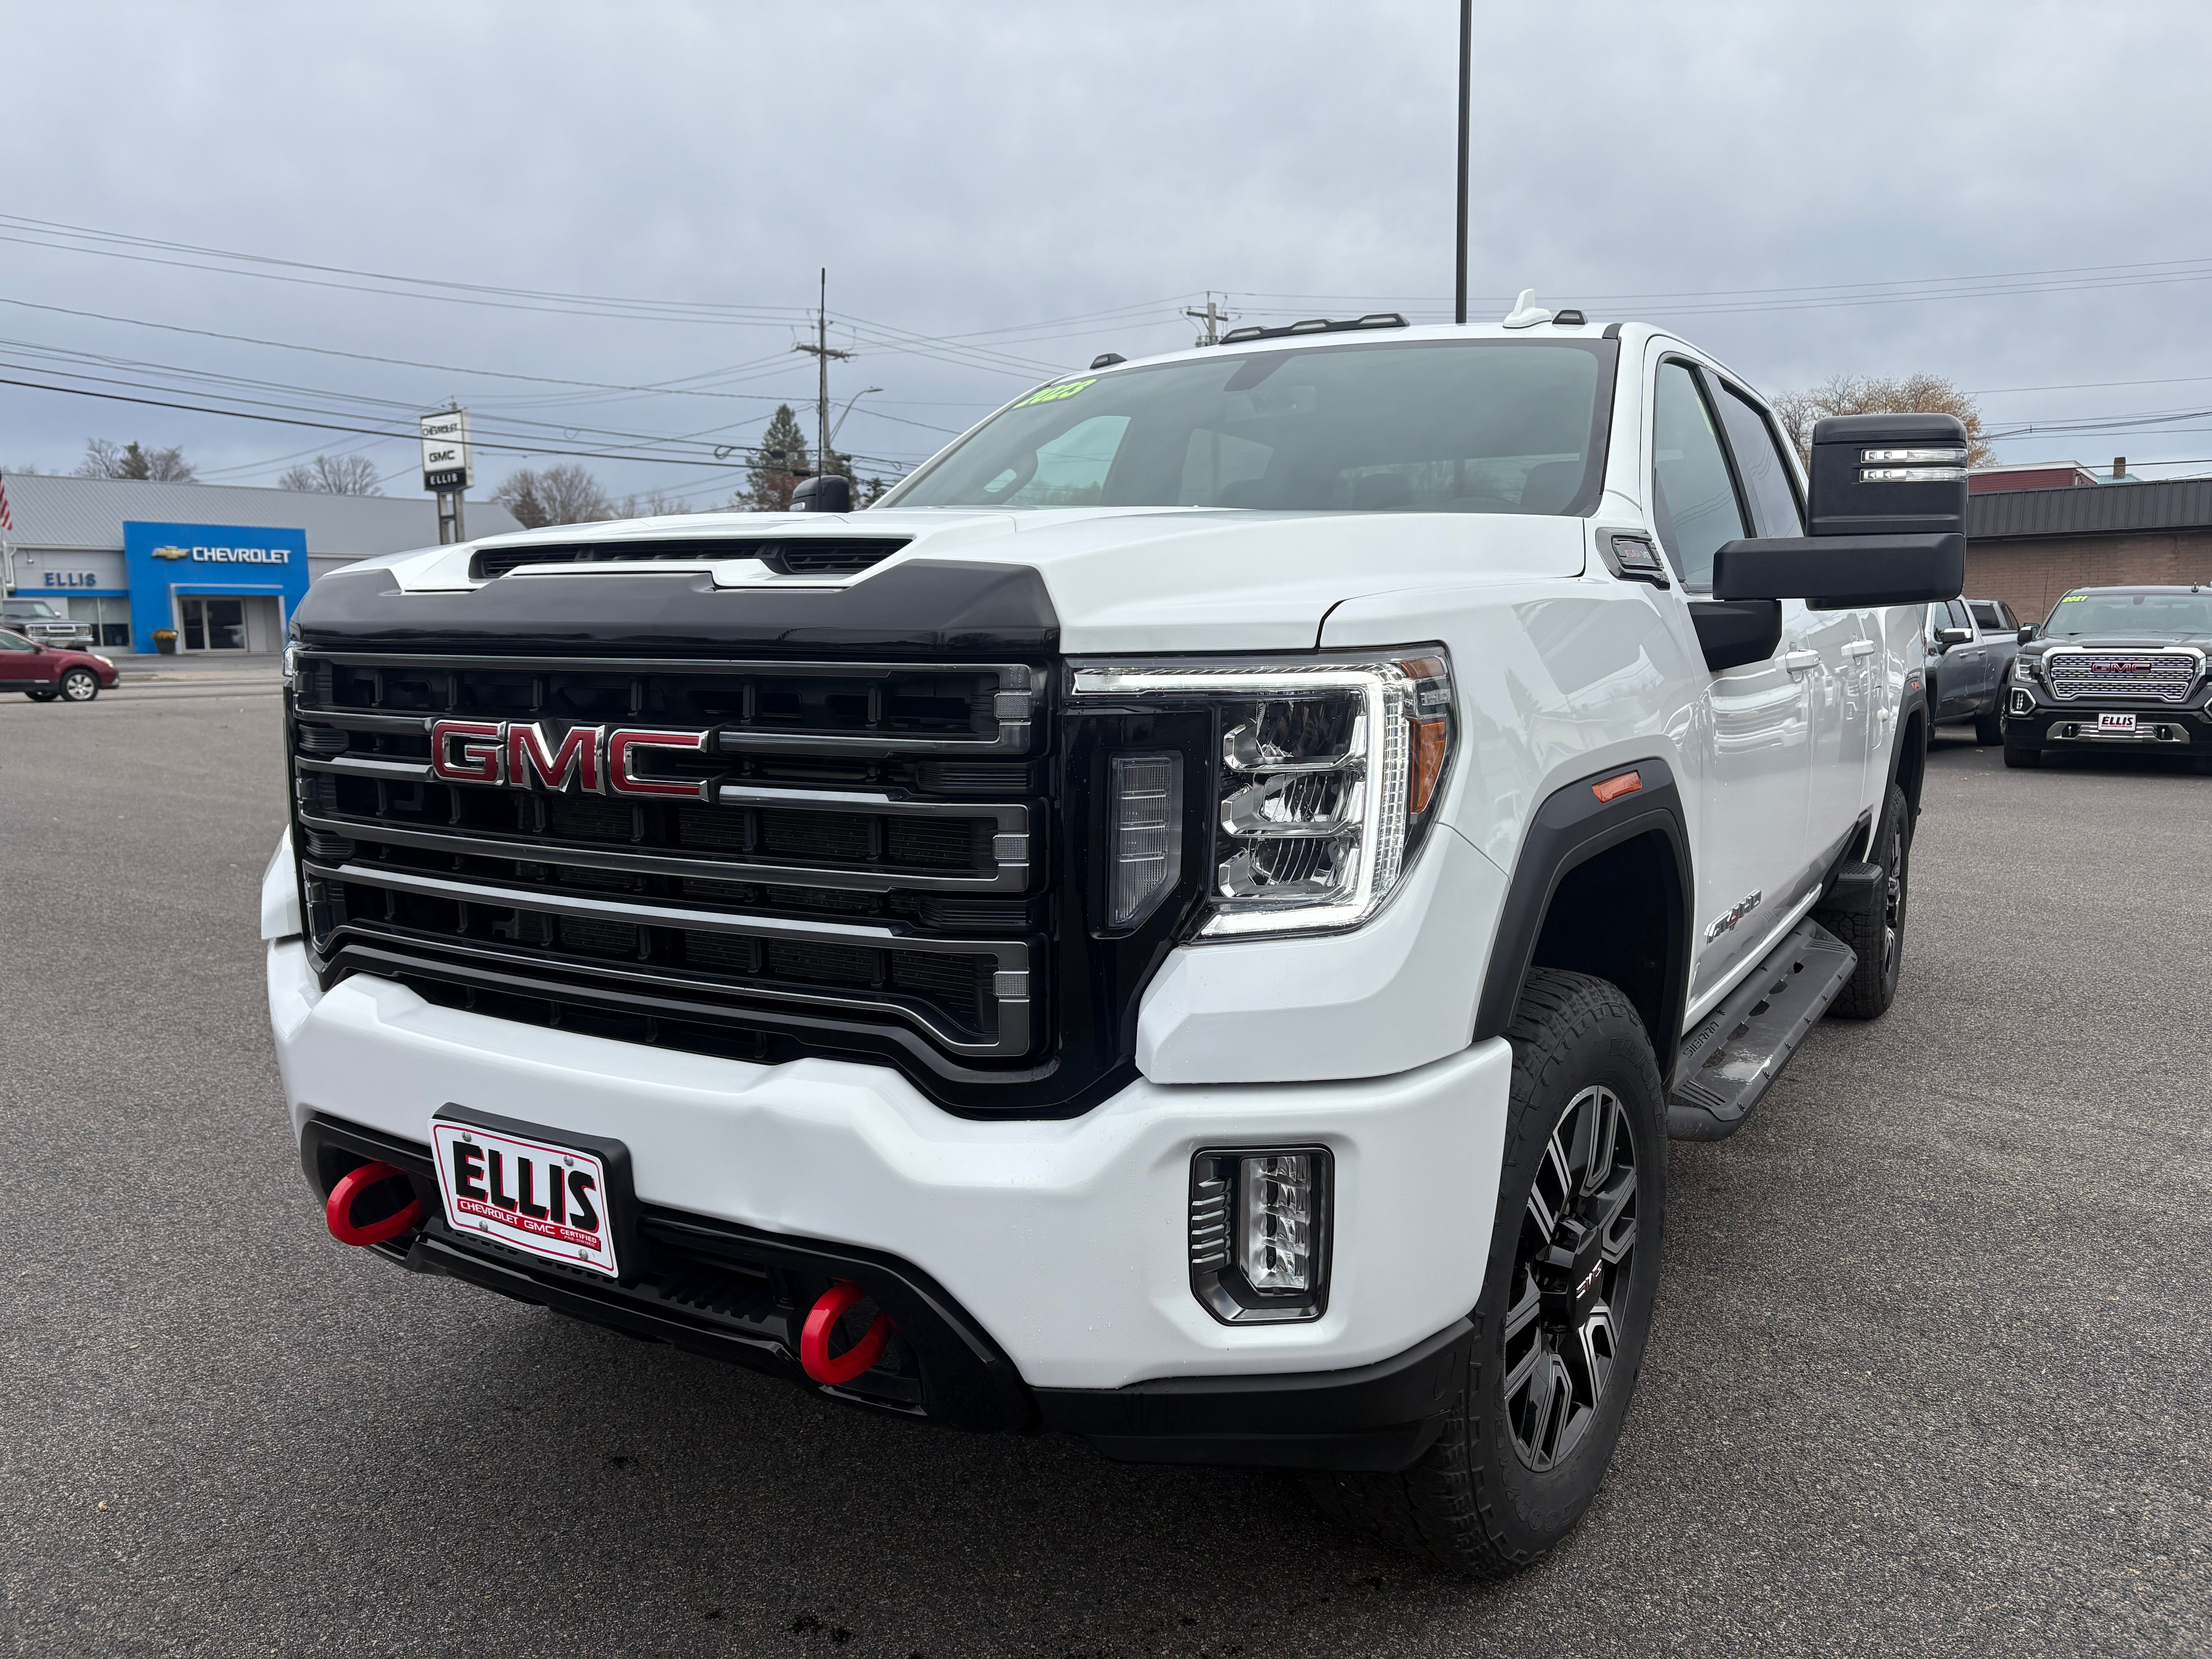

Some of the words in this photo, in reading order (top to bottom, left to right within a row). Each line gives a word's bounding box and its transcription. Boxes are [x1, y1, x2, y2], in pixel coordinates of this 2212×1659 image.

[423, 423, 458, 435] CHEVROLET
[429, 450, 455, 462] GMC
[429, 473, 458, 485] ELLIS
[192, 546, 291, 564] CHEVROLET
[44, 572, 96, 587] ELLIS
[2093, 663, 2150, 673] GMC
[2102, 716, 2133, 725] ELLIS
[431, 719, 709, 802] GMC
[1682, 1021, 1719, 1059] SIERRA
[452, 1140, 599, 1234] ELLIS
[460, 1201, 518, 1224] CHEVROLET
[524, 1220, 555, 1234] GMC
[560, 1229, 597, 1243] CERTIFIED
[564, 1235, 595, 1247] PRE-OWNED
